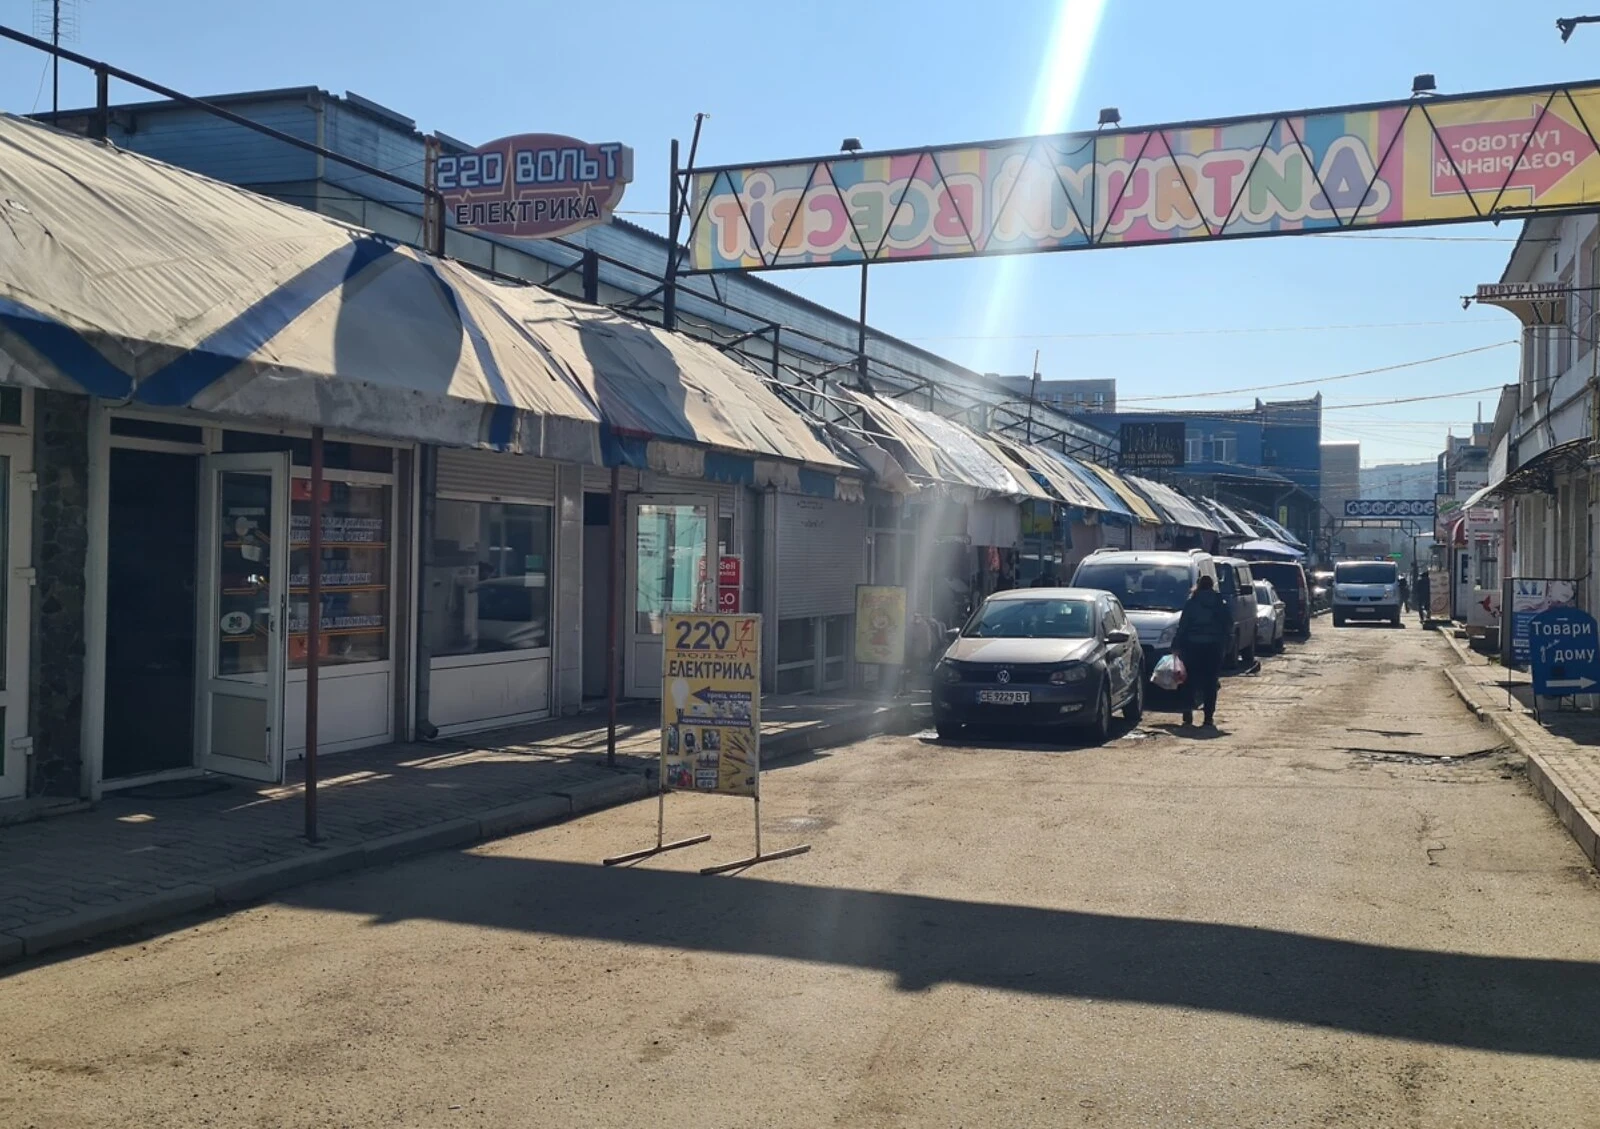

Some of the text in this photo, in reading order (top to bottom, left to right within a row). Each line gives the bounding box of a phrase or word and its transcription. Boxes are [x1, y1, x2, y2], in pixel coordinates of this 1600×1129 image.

[437, 143, 622, 188] 220 ВОЛЬТ
[455, 197, 599, 225] ЕЛЕКТРИКА
[1516, 580, 1543, 596] XL
[675, 621, 730, 649] 220
[1532, 621, 1591, 638] Товари
[1554, 649, 1595, 664] дому
[669, 660, 754, 680] ЕЛЕКТРИКА
